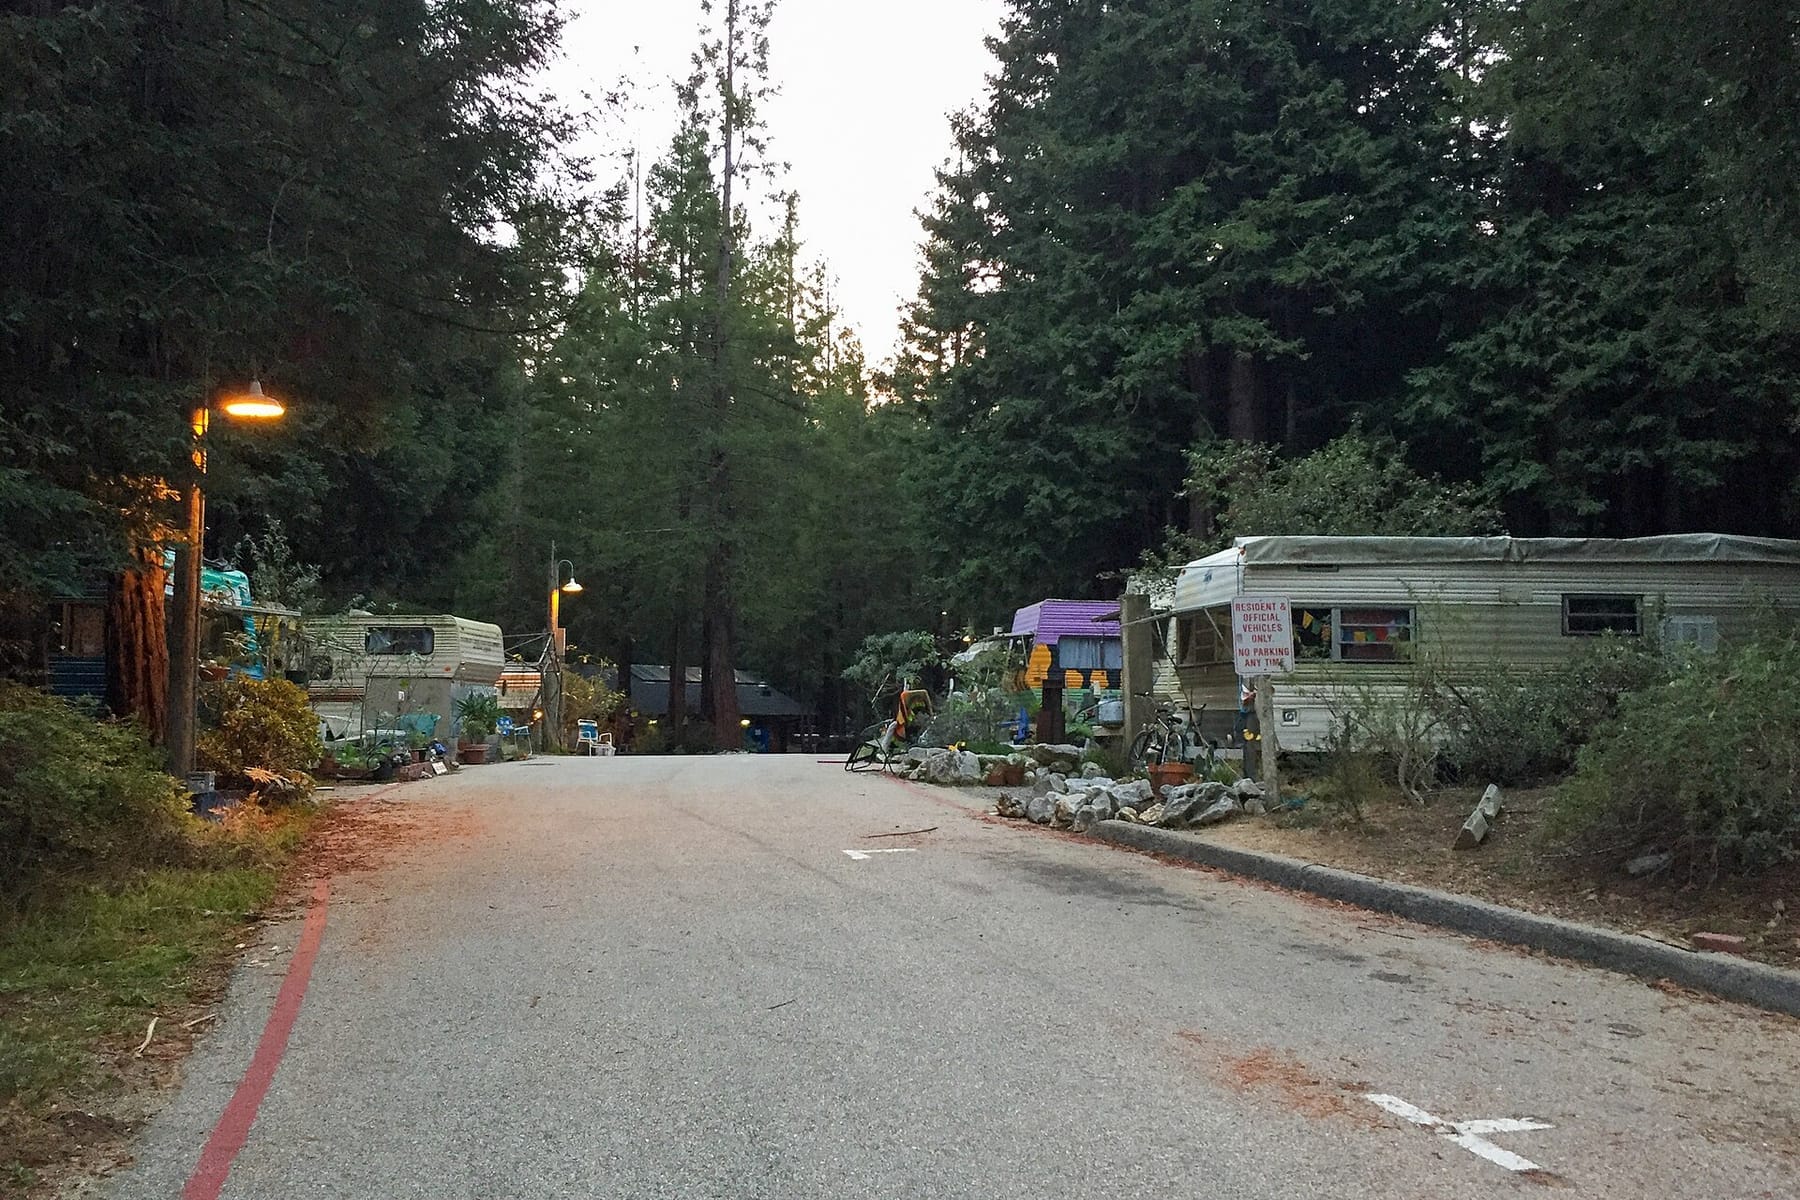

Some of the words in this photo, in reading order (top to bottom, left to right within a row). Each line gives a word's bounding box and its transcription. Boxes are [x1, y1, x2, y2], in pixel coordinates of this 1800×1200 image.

[1235, 603, 1276, 611] RESIDENT
[1243, 613, 1280, 622] OFFICIAL
[1243, 624, 1282, 632] VEHICLES
[1238, 648, 1249, 656] NO
[1254, 648, 1289, 656] PARKING
[1265, 658, 1284, 666] TIM
